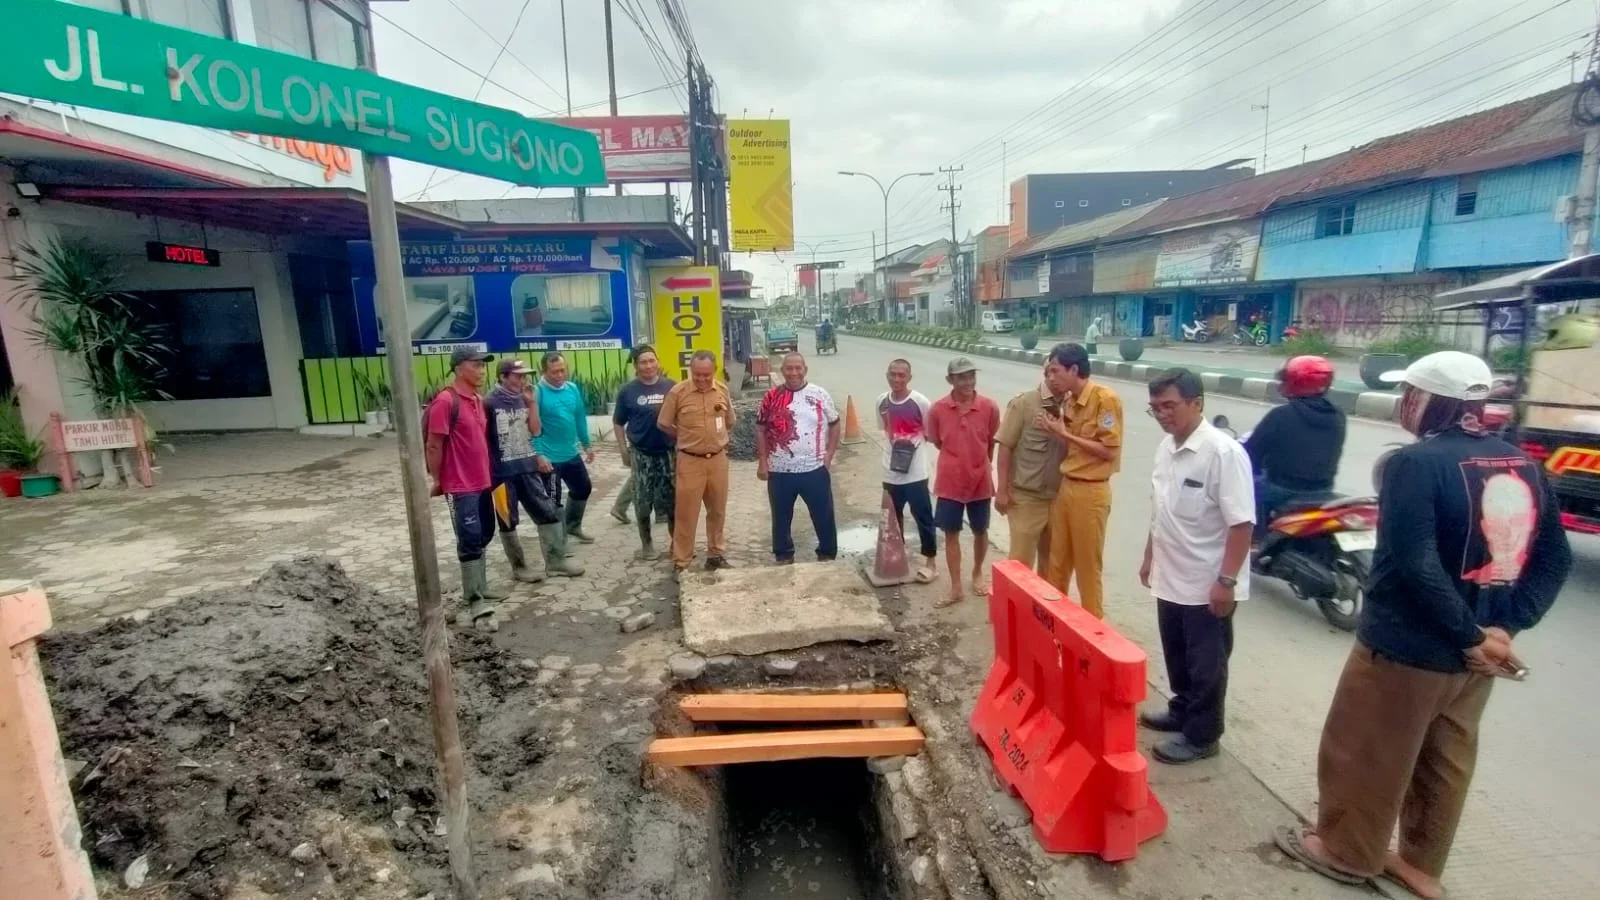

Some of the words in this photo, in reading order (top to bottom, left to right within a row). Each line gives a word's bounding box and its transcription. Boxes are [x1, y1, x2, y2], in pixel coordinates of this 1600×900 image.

[44, 25, 144, 95] JL.
[166, 47, 411, 142] KOLONEL
[425, 106, 584, 176] SUGIONO
[729, 128, 762, 138] Outdoor
[742, 139, 788, 149] Advertising
[165, 246, 208, 264] HOTEL
[400, 244, 446, 255] TARIF
[451, 244, 498, 254] LIBUR
[503, 243, 565, 254] NATARU
[409, 257, 423, 265] AC
[425, 257, 440, 266] Rp.
[444, 256, 479, 265] 120.000
[493, 256, 506, 264] AC
[508, 256, 524, 265] Rp.
[511, 264, 549, 273] HOTEL
[64, 423, 99, 435] PARKIR
[73, 435, 98, 447] TAMU
[101, 433, 129, 444] HOTEL
